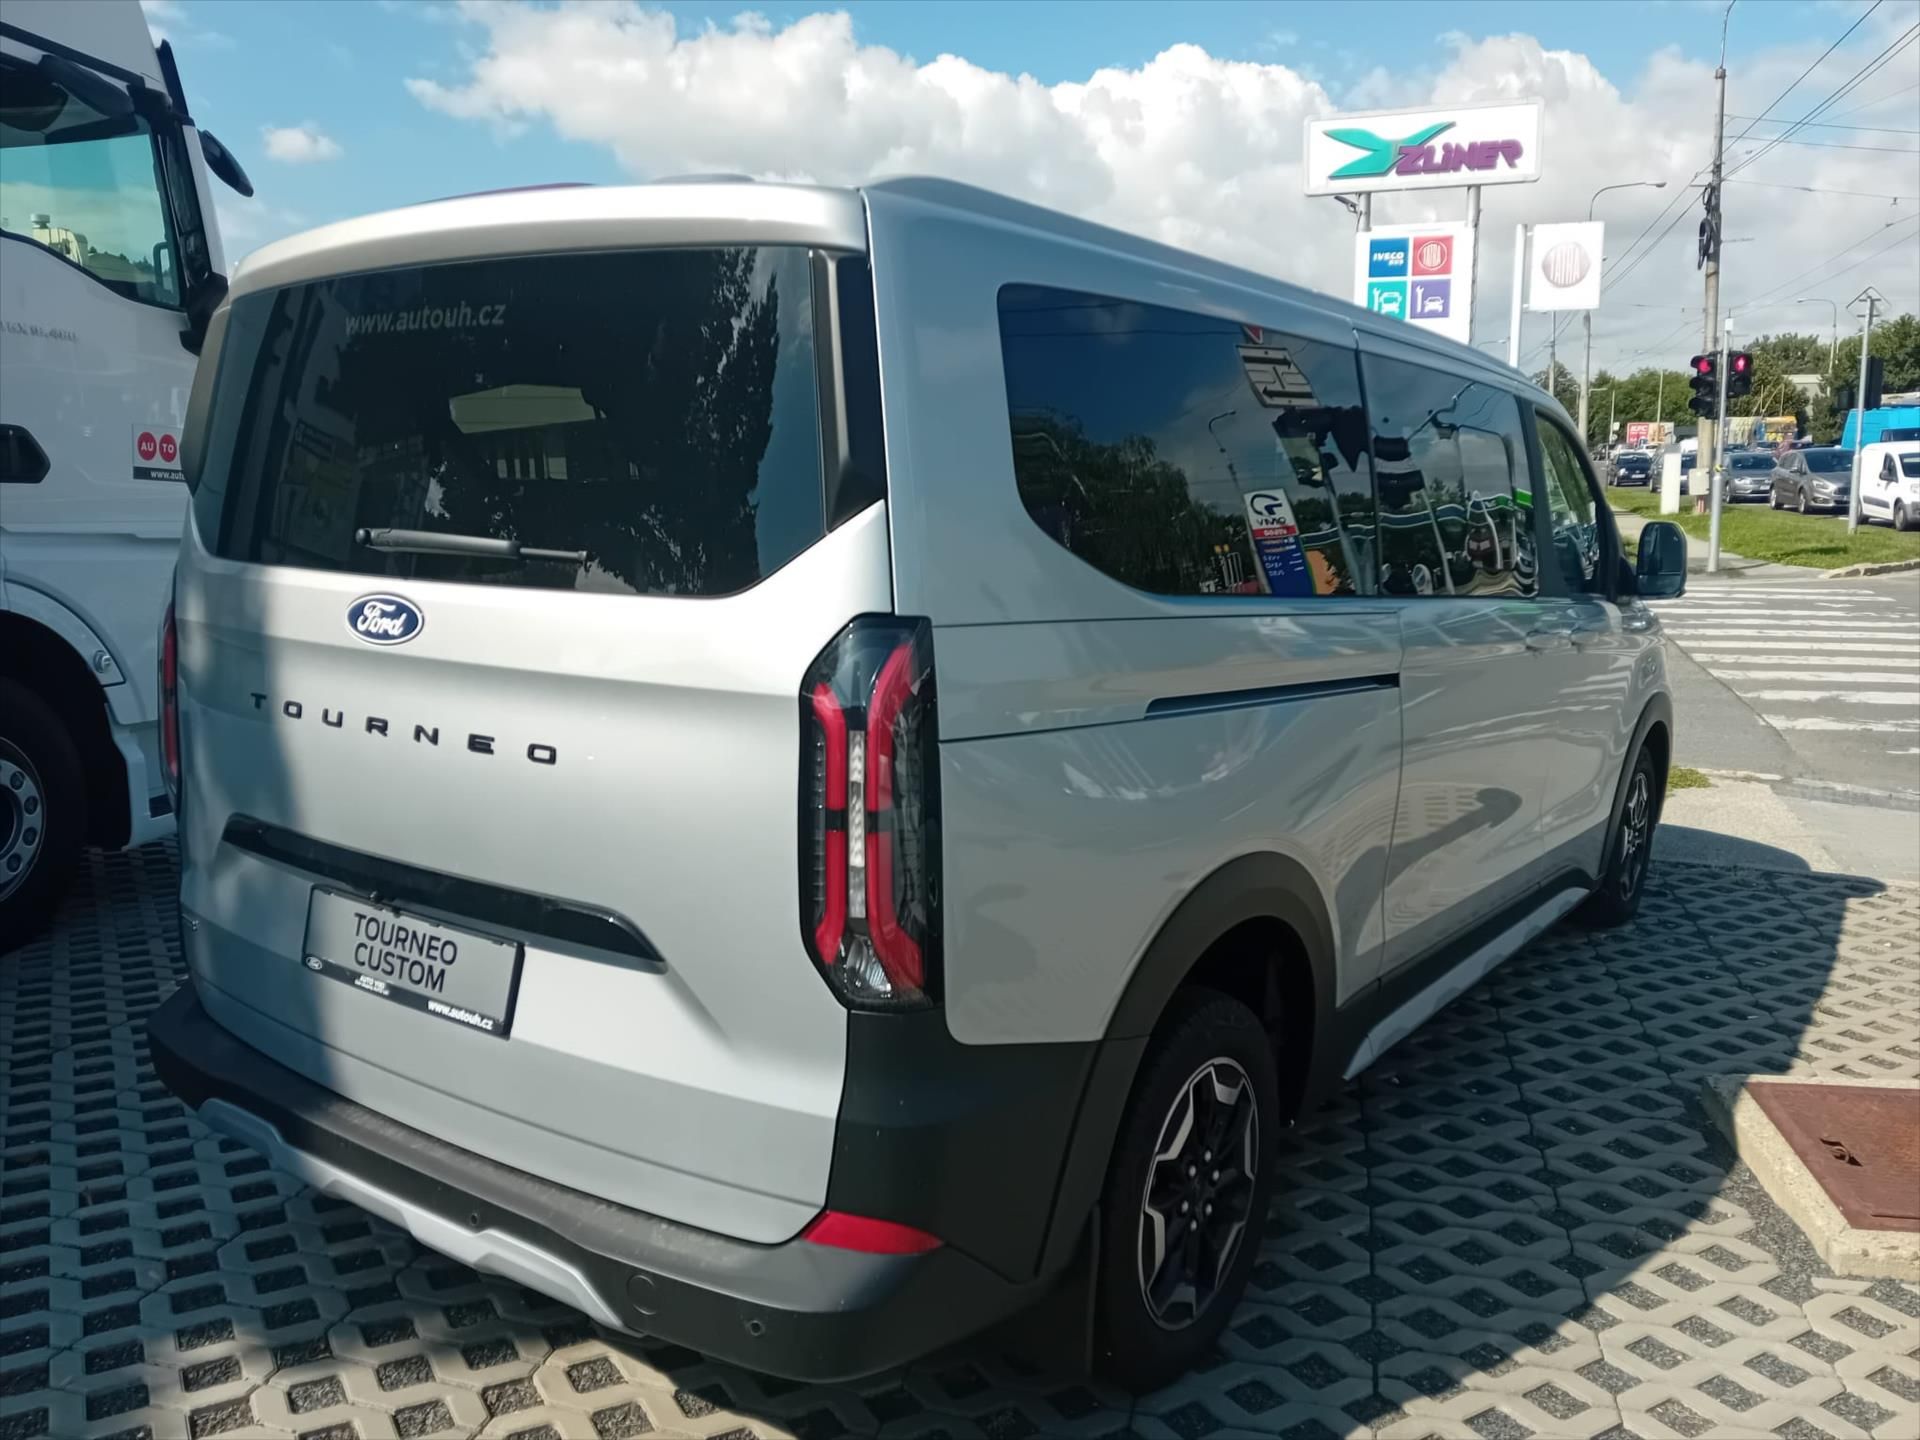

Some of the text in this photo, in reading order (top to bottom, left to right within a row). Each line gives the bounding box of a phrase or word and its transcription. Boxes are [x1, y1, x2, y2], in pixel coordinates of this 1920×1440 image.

[1373, 251, 1405, 262] IVECO
[344, 301, 507, 337] www.autouh.cz
[140, 442, 175, 454] AU TO
[356, 601, 408, 636] Ford
[249, 692, 558, 766] TOURNEO
[353, 912, 458, 966] TOURNEO
[353, 942, 446, 993] CUSTOM
[427, 1000, 494, 1031] www.autouh.cz
